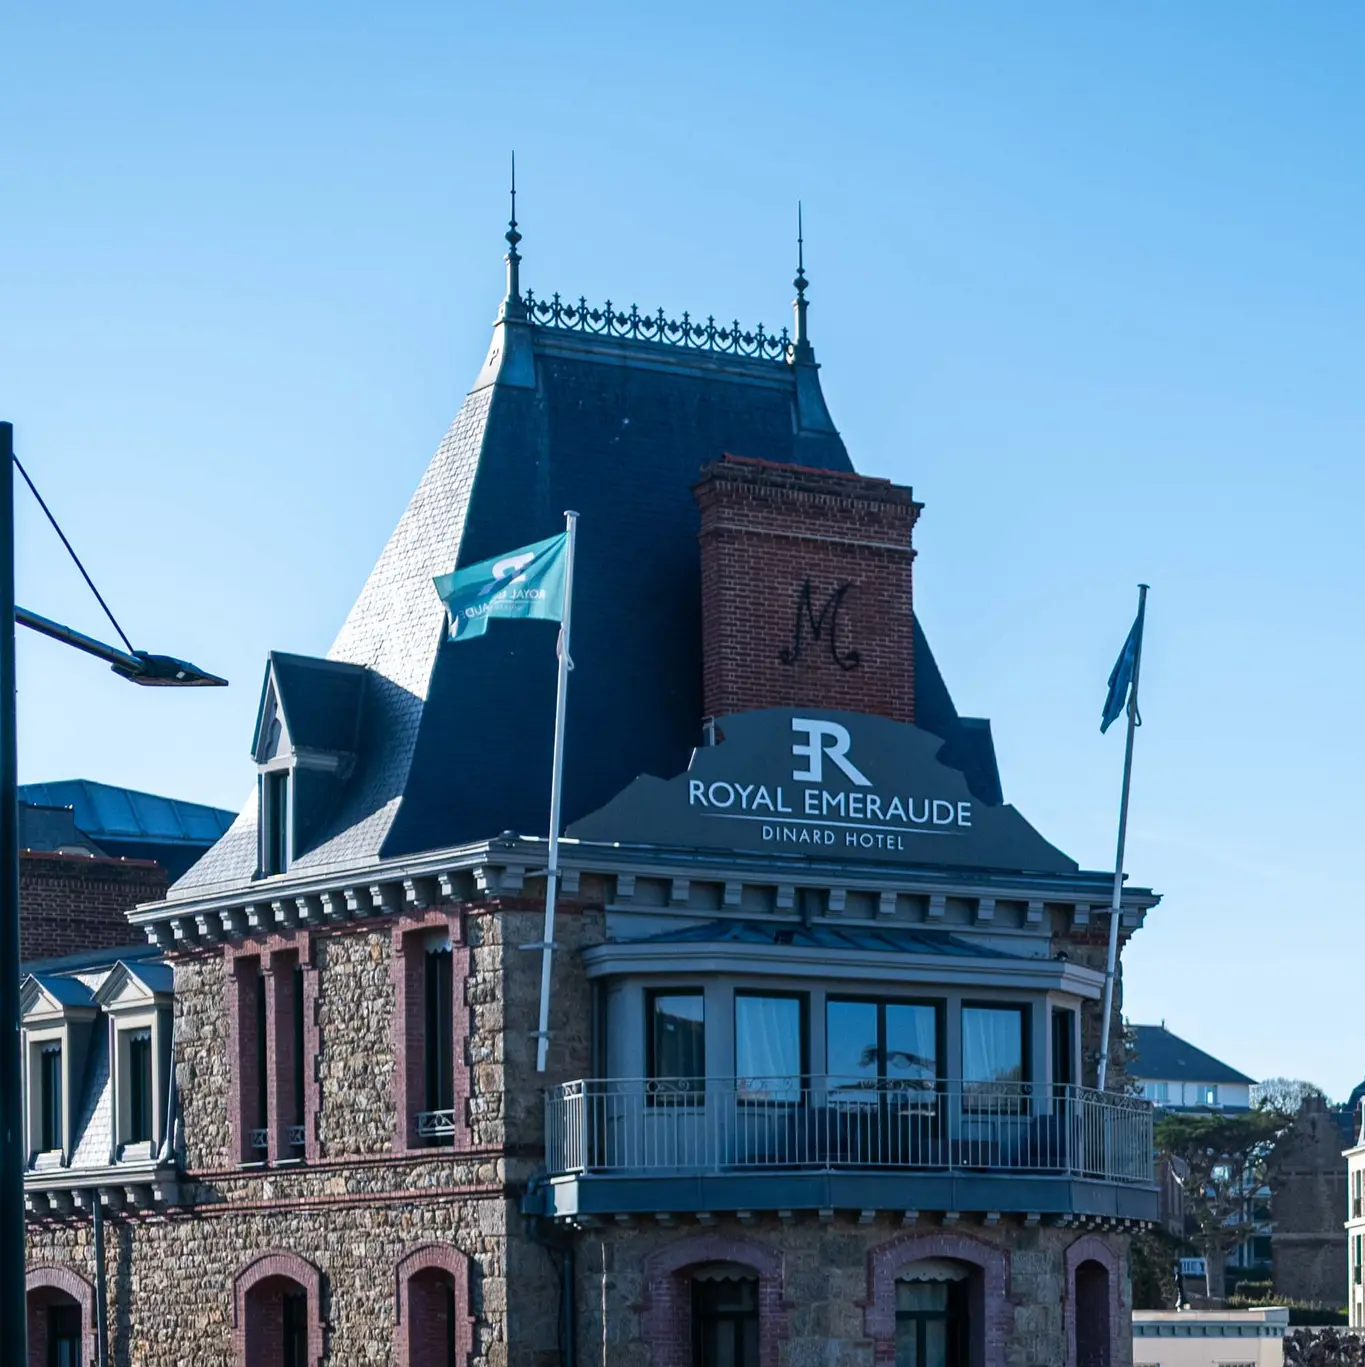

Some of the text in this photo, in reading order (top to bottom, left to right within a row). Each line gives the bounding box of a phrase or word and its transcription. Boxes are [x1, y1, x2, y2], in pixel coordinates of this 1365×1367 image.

[688, 779, 972, 827] ROYAL EMERAUDE
[762, 824, 905, 851] DINARD HOTEL
